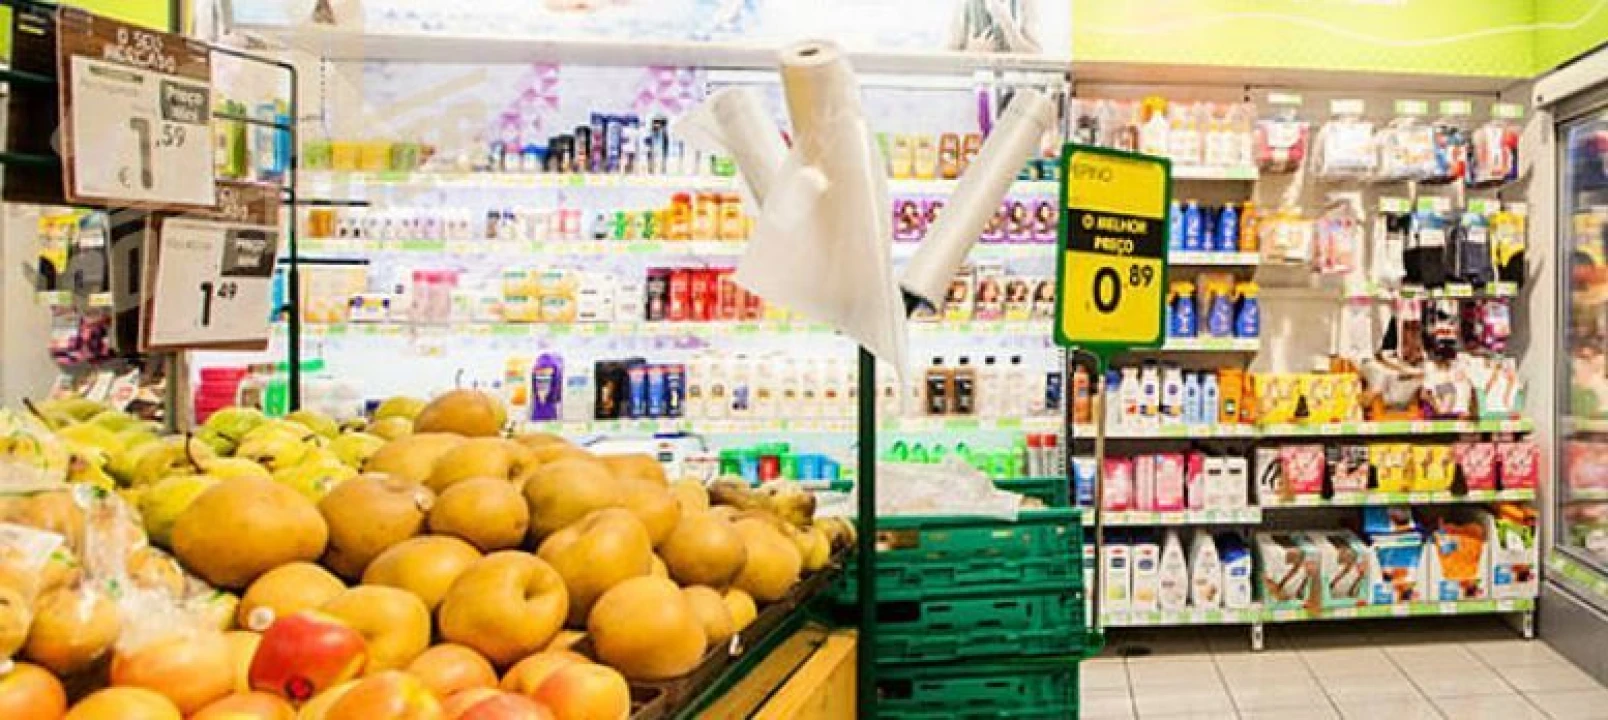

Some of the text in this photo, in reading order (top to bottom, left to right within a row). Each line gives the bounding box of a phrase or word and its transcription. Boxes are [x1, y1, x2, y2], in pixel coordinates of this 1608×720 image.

[130, 117, 152, 190] 1
[1081, 213, 1148, 235] O MELHOR
[1094, 236, 1135, 255] PREÇO
[200, 281, 213, 328] 1
[1093, 266, 1122, 314] 0
